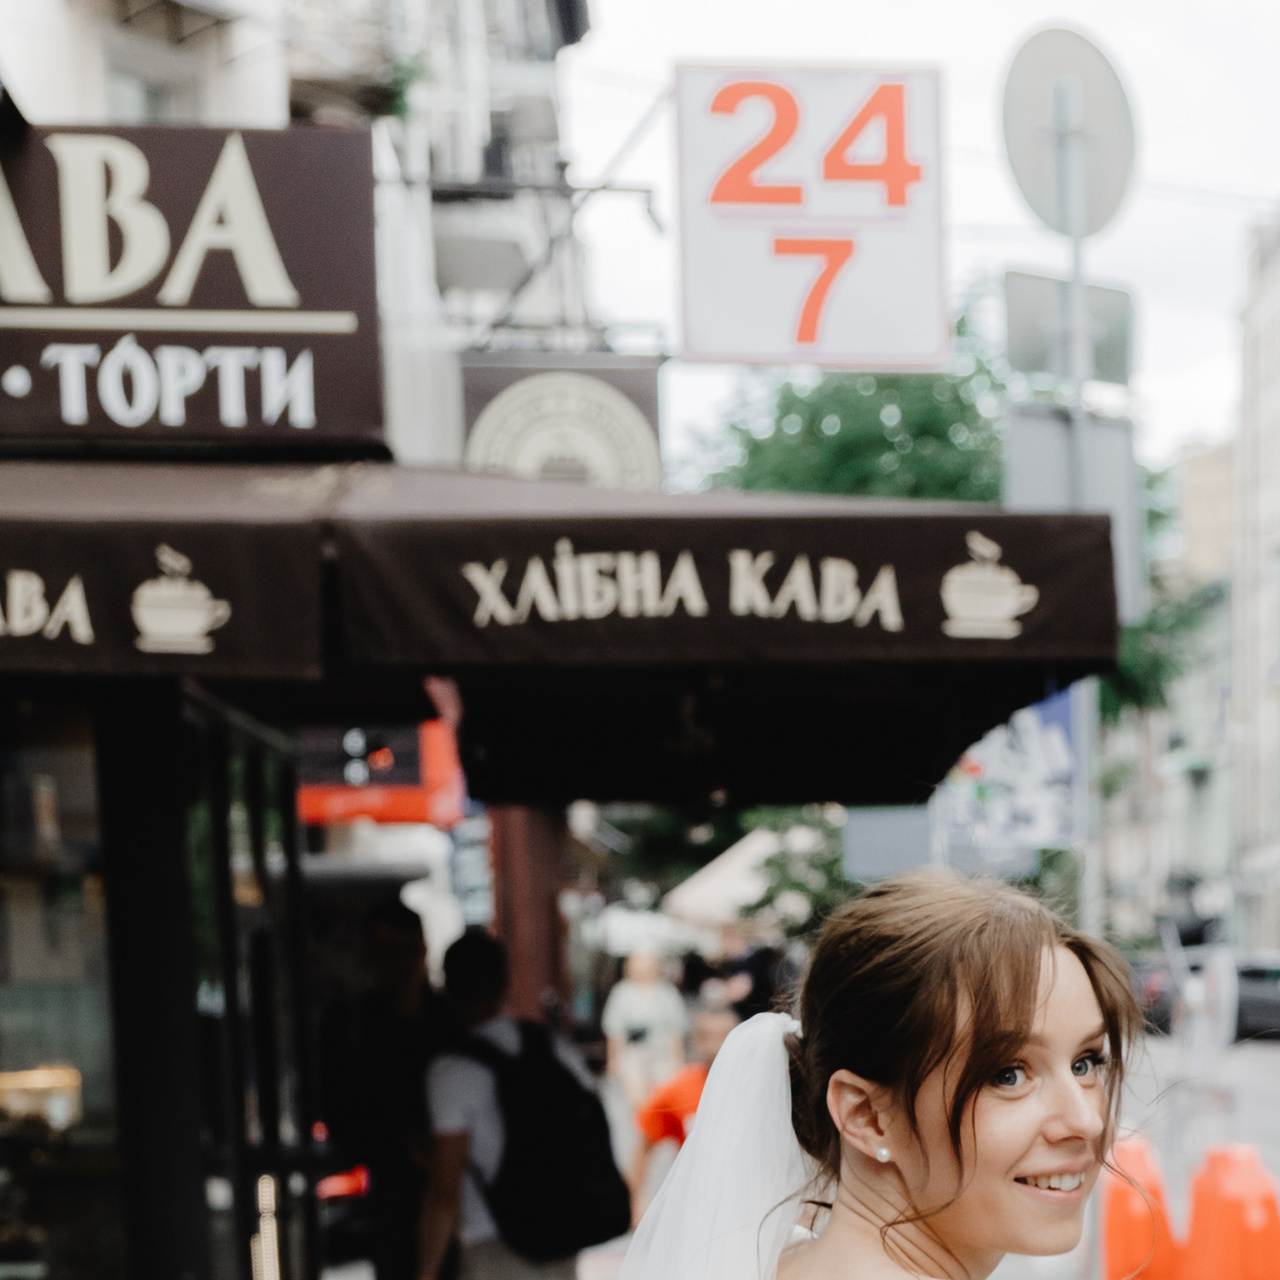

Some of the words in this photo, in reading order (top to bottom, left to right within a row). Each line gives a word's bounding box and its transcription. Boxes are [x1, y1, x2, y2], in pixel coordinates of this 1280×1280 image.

[708, 80, 922, 207] 24
[773, 237, 855, 345] 7
[40, 332, 316, 429] ТОРТИ
[0, 569, 95, 645] ВА
[461, 537, 709, 628] ХЛІБНА
[728, 548, 904, 632] КАВА
